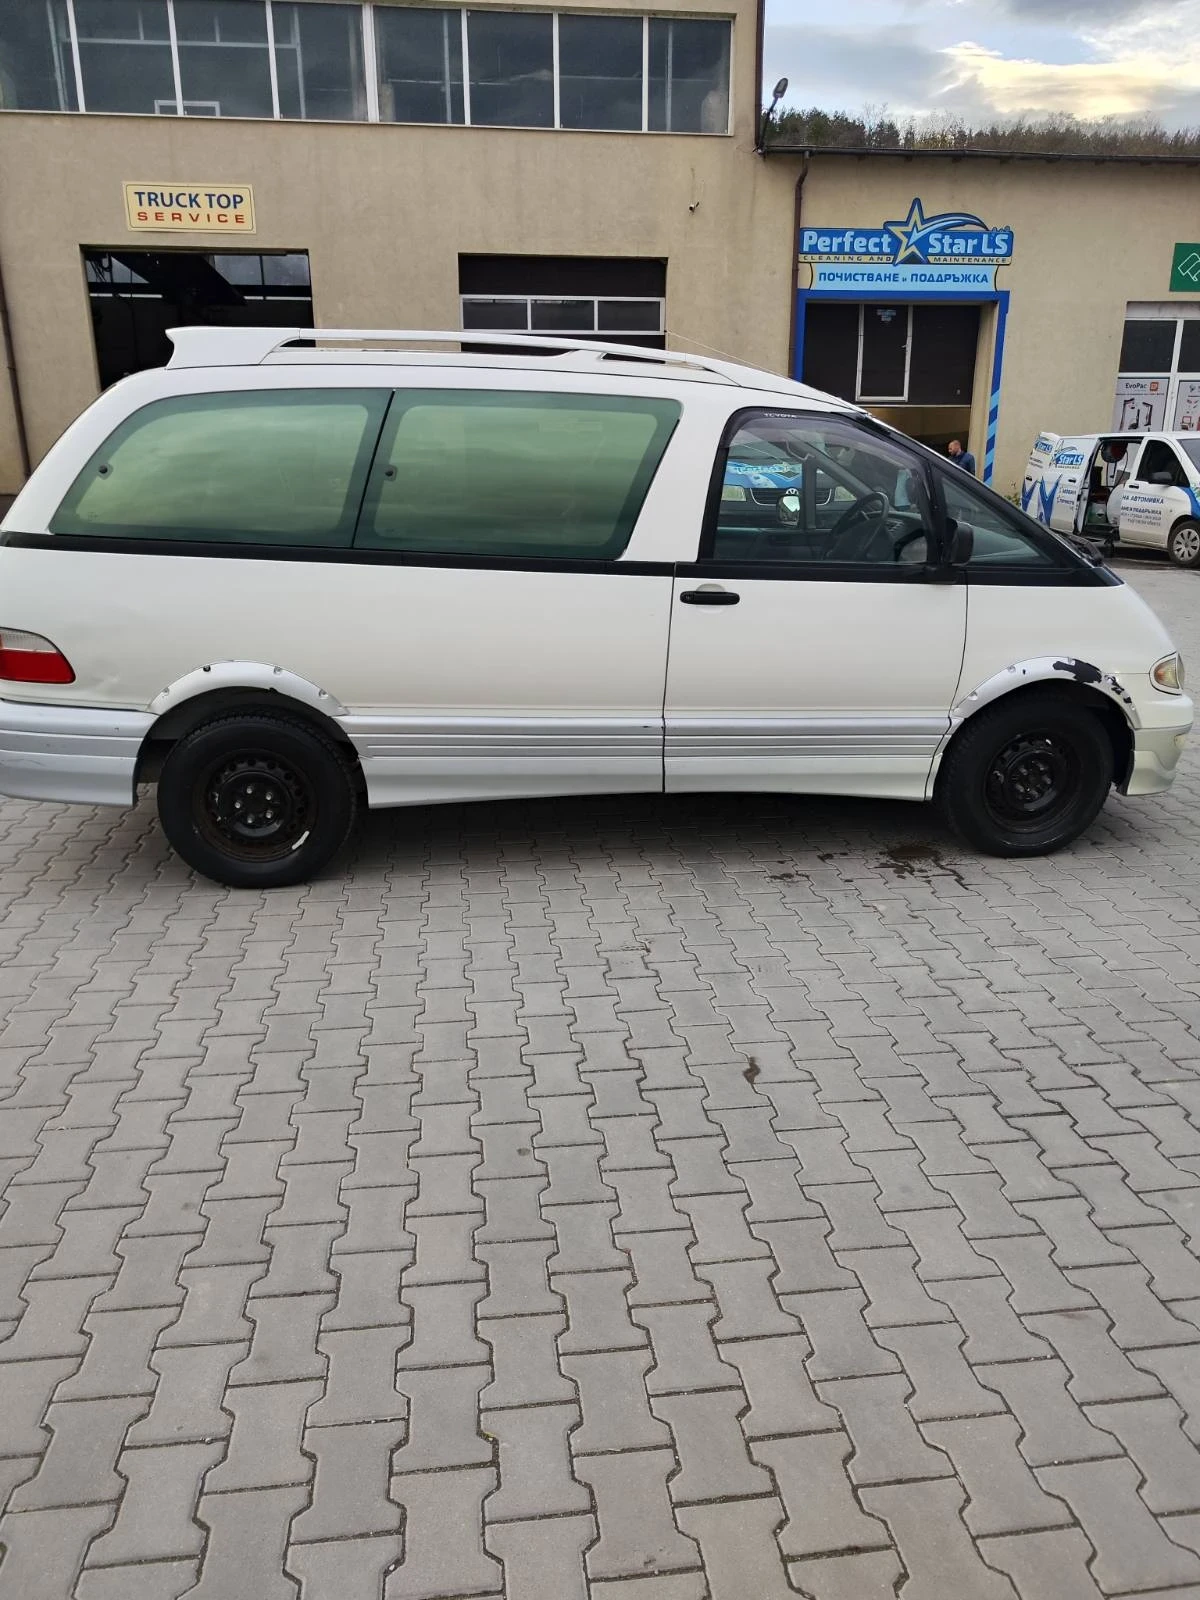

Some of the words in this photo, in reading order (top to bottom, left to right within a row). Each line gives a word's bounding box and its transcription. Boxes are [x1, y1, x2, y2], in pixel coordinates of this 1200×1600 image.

[134, 191, 202, 209] TRUCK
[204, 193, 244, 209] TOP
[137, 211, 245, 224] SERVICE
[803, 230, 892, 253] Perfect
[928, 233, 977, 254] Star
[982, 233, 1009, 255] LS
[818, 272, 900, 282] ПОЧИСТВАНЕ
[910, 273, 989, 283] ПОДДРЪЖКА
[1131, 495, 1164, 504] АВТОМИВКА
